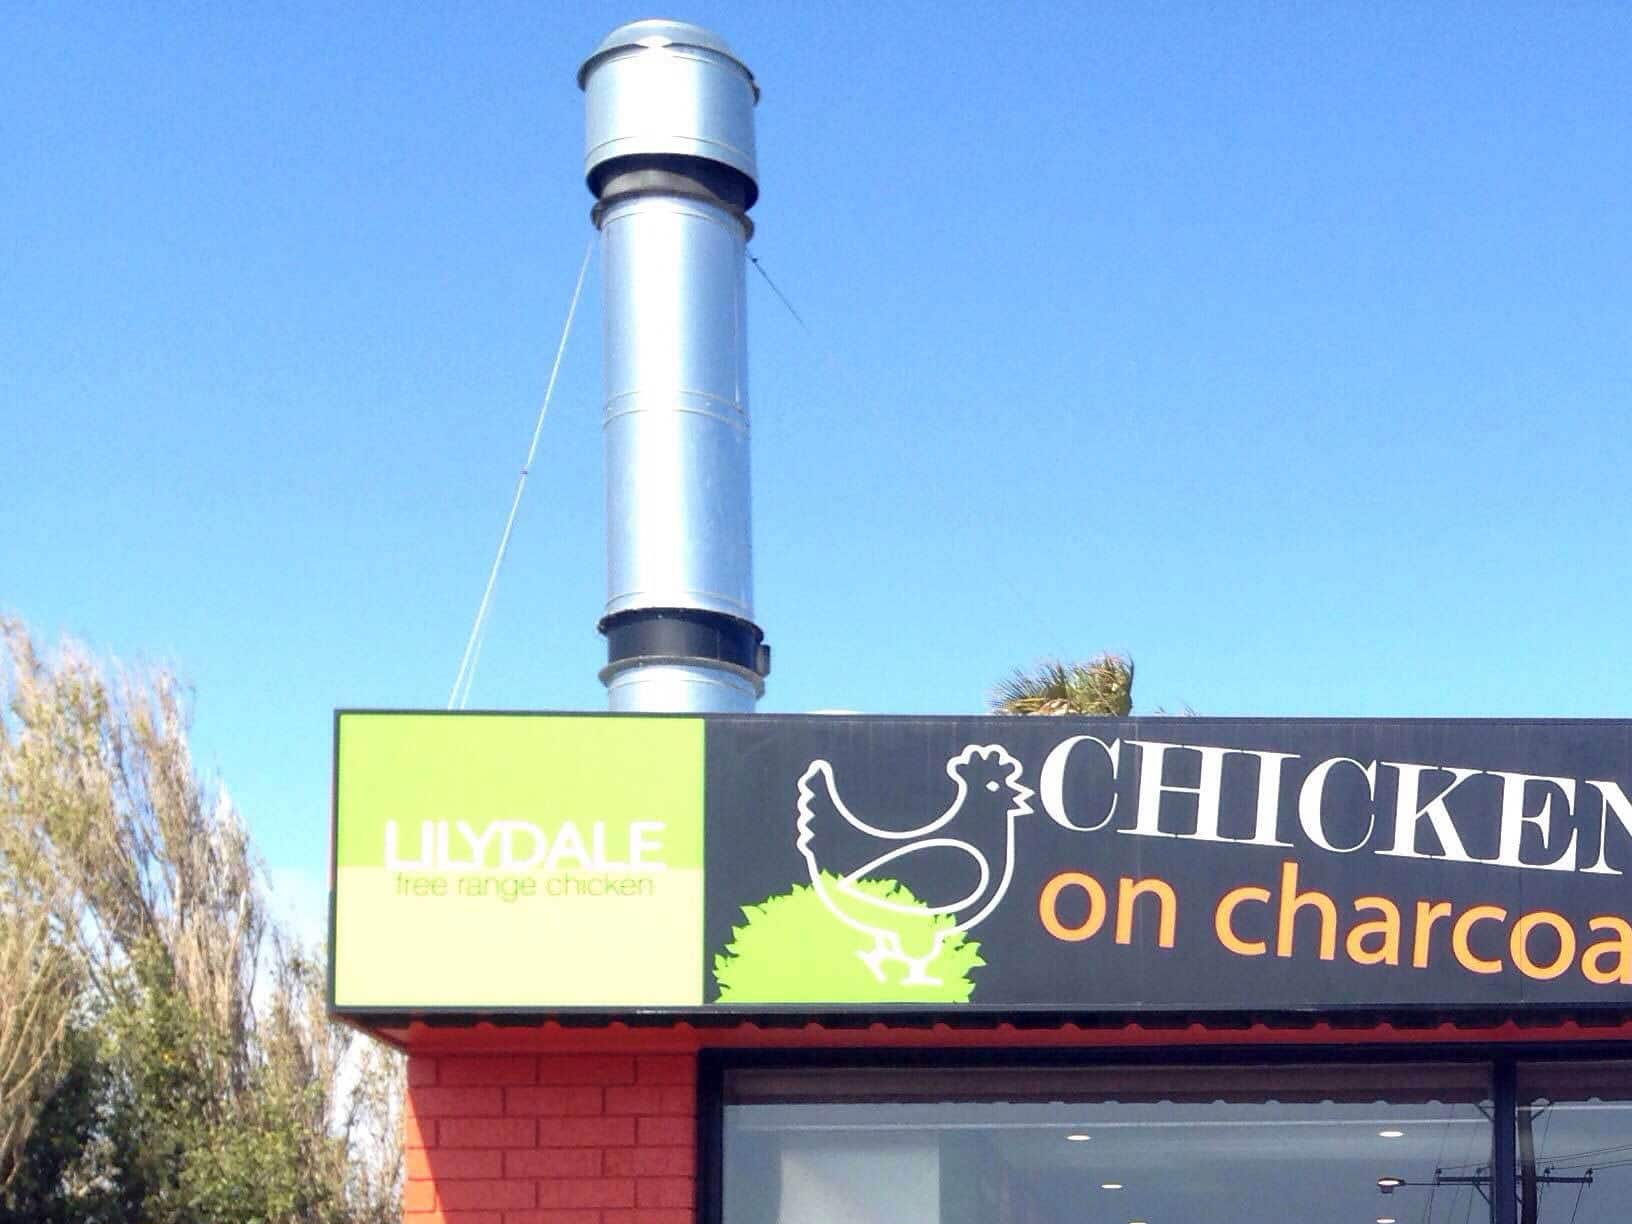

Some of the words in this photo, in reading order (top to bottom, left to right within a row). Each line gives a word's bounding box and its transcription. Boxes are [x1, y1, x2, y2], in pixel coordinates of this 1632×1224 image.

[384, 819, 669, 872] LILYDALE
[394, 874, 447, 896] free
[457, 875, 536, 903] range
[545, 873, 655, 896] chicken
[1038, 871, 1178, 950] on
